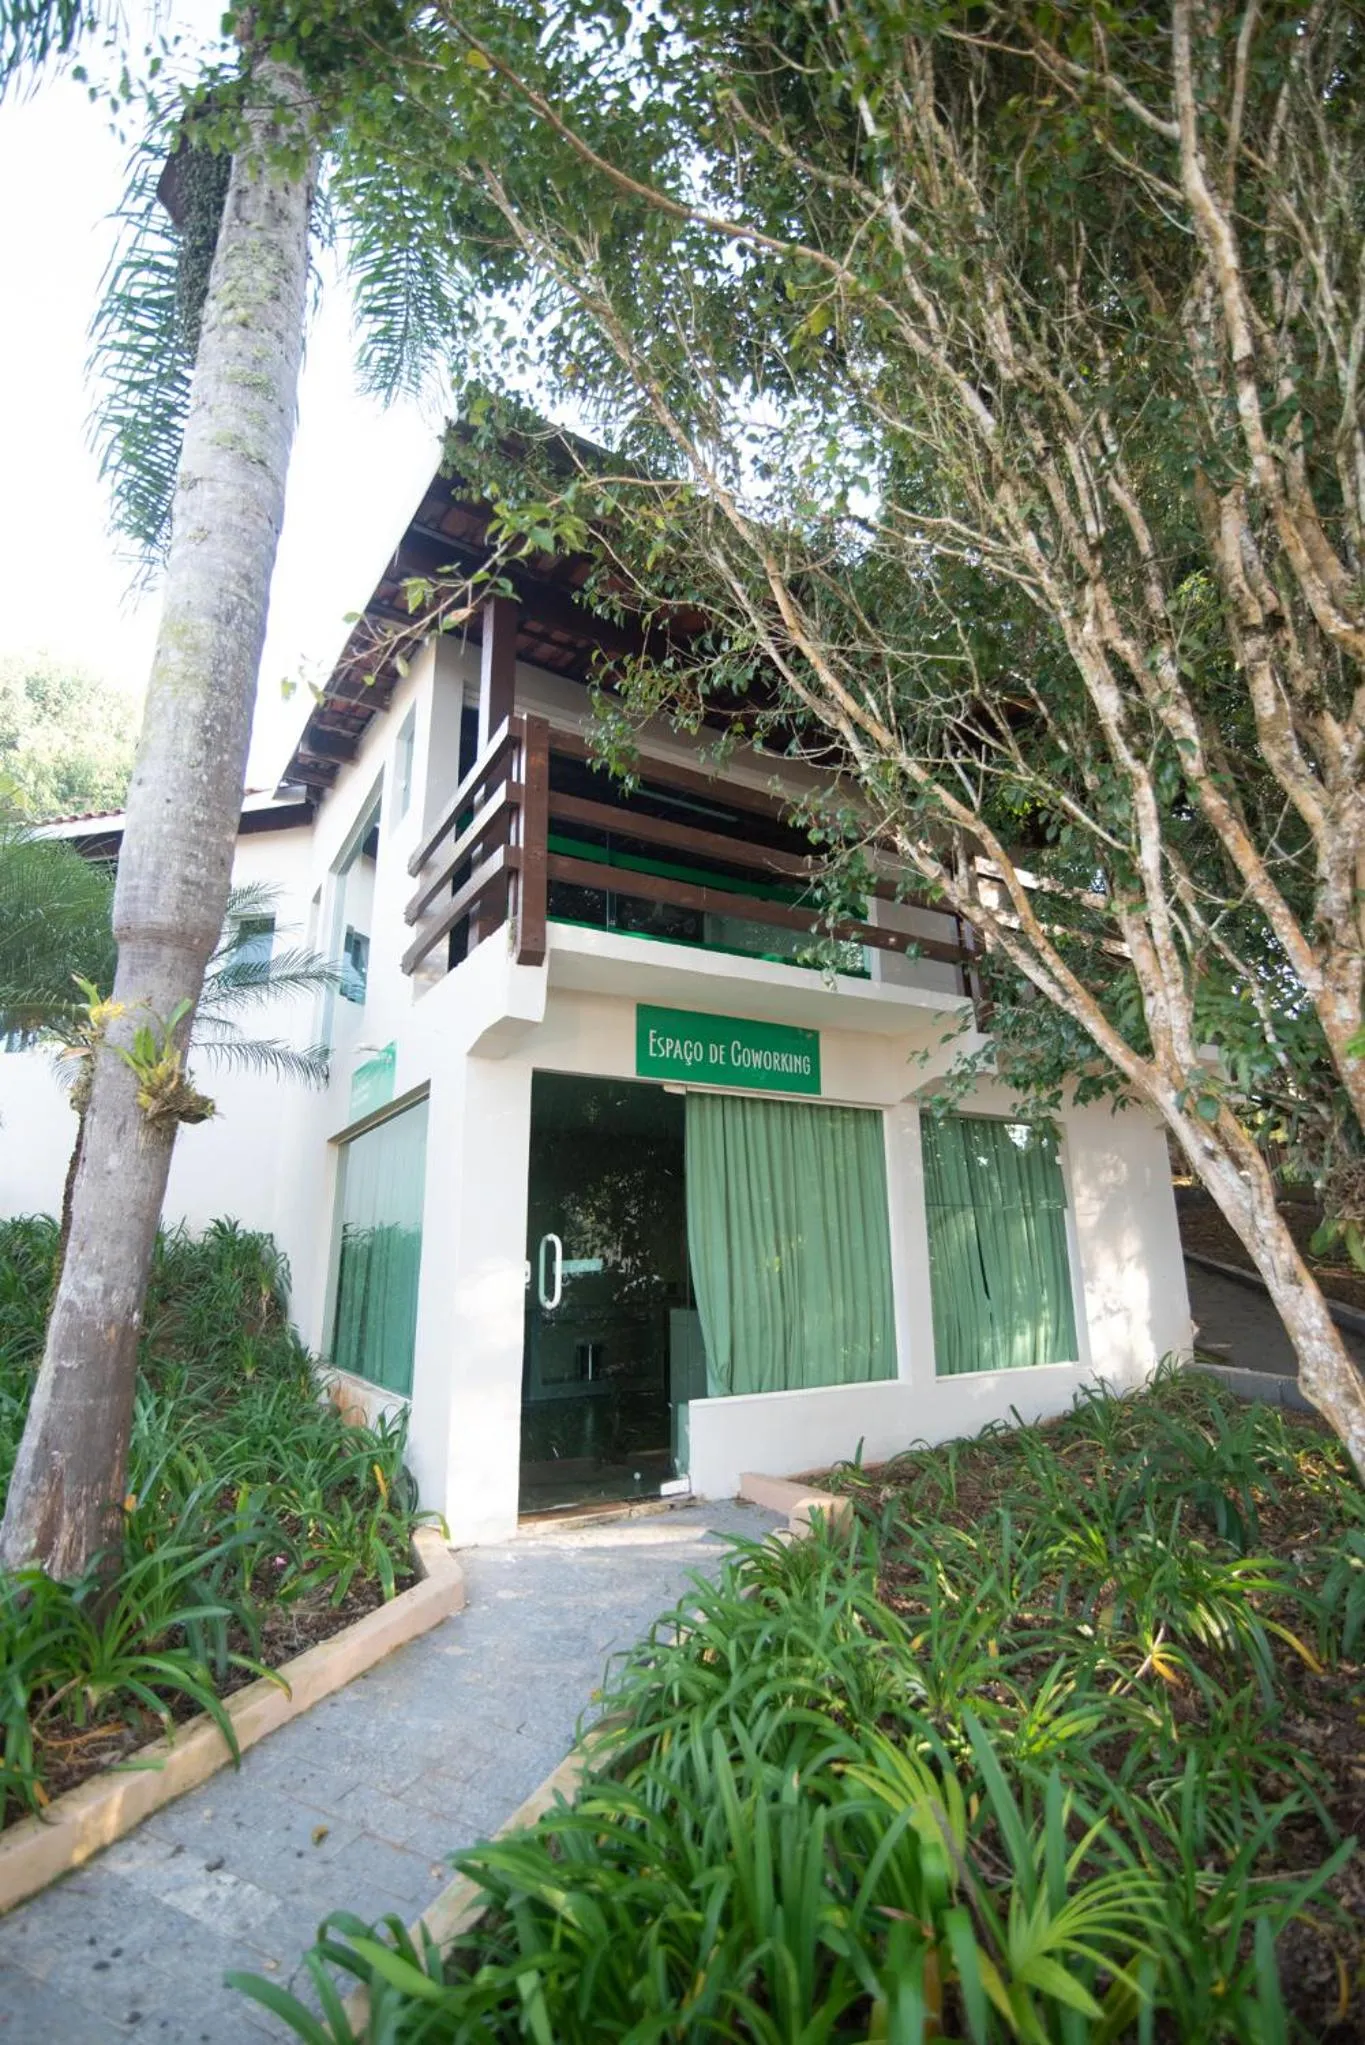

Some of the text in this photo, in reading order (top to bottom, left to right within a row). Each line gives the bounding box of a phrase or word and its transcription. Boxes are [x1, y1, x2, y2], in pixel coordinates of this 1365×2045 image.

[649, 1029, 811, 1076] ESPAÇO DE COWORKING
